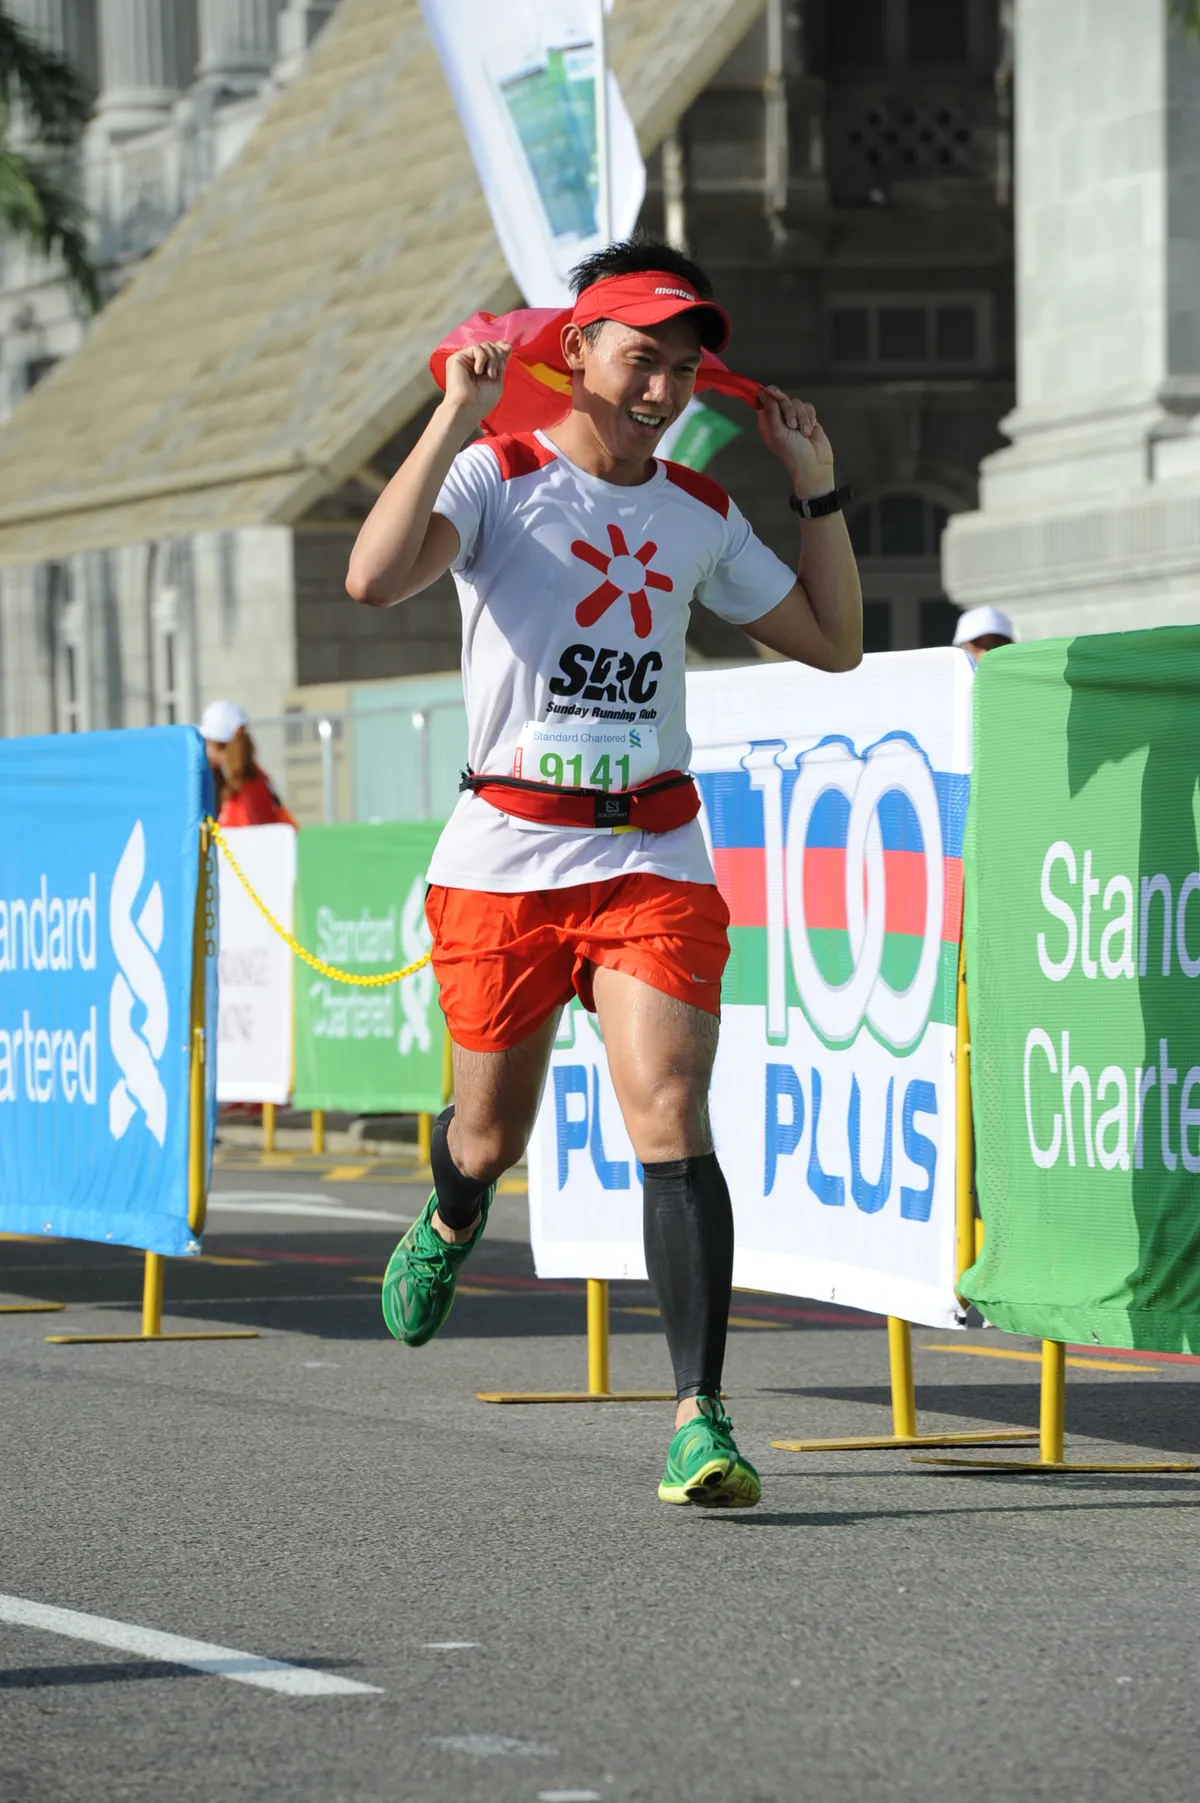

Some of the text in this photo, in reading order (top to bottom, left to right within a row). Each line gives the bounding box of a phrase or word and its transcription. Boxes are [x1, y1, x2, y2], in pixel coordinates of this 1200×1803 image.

[533, 730, 627, 743] Standard Chartered
[546, 701, 590, 718] Sunday
[591, 706, 636, 723] Running
[539, 752, 630, 792] 9141
[741, 730, 943, 1057] 100
[552, 1063, 644, 1192] PL
[763, 1063, 938, 1223] PLUS
